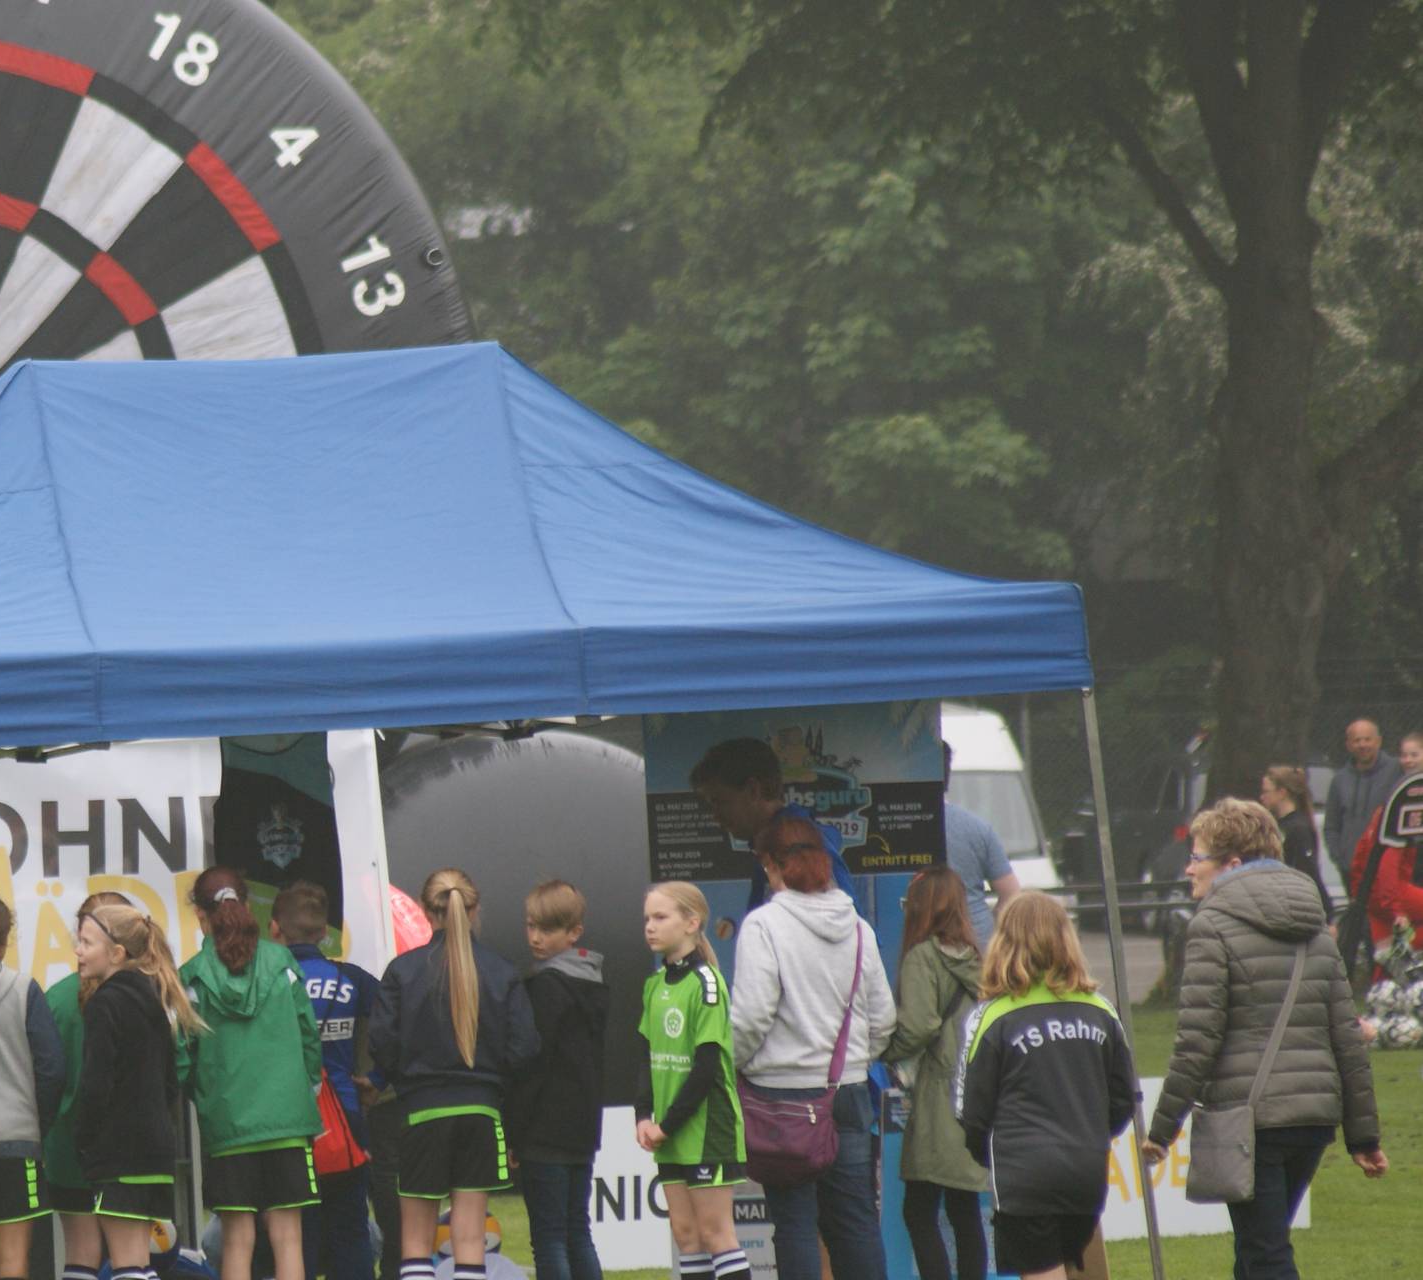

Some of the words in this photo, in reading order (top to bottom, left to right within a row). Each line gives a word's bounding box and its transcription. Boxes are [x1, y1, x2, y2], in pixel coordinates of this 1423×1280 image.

[149, 13, 220, 86] 18
[269, 126, 319, 169] 4
[340, 235, 406, 317] 13
[862, 855, 909, 867] EINTRITT
[910, 853, 933, 865] FREI
[306, 978, 354, 1003] GES
[1012, 1027, 1044, 1055] TS
[1047, 1019, 1107, 1046] Rahm
[594, 1175, 670, 1223] NIC
[734, 1204, 765, 1219] MAI
[740, 1239, 765, 1249] uru
